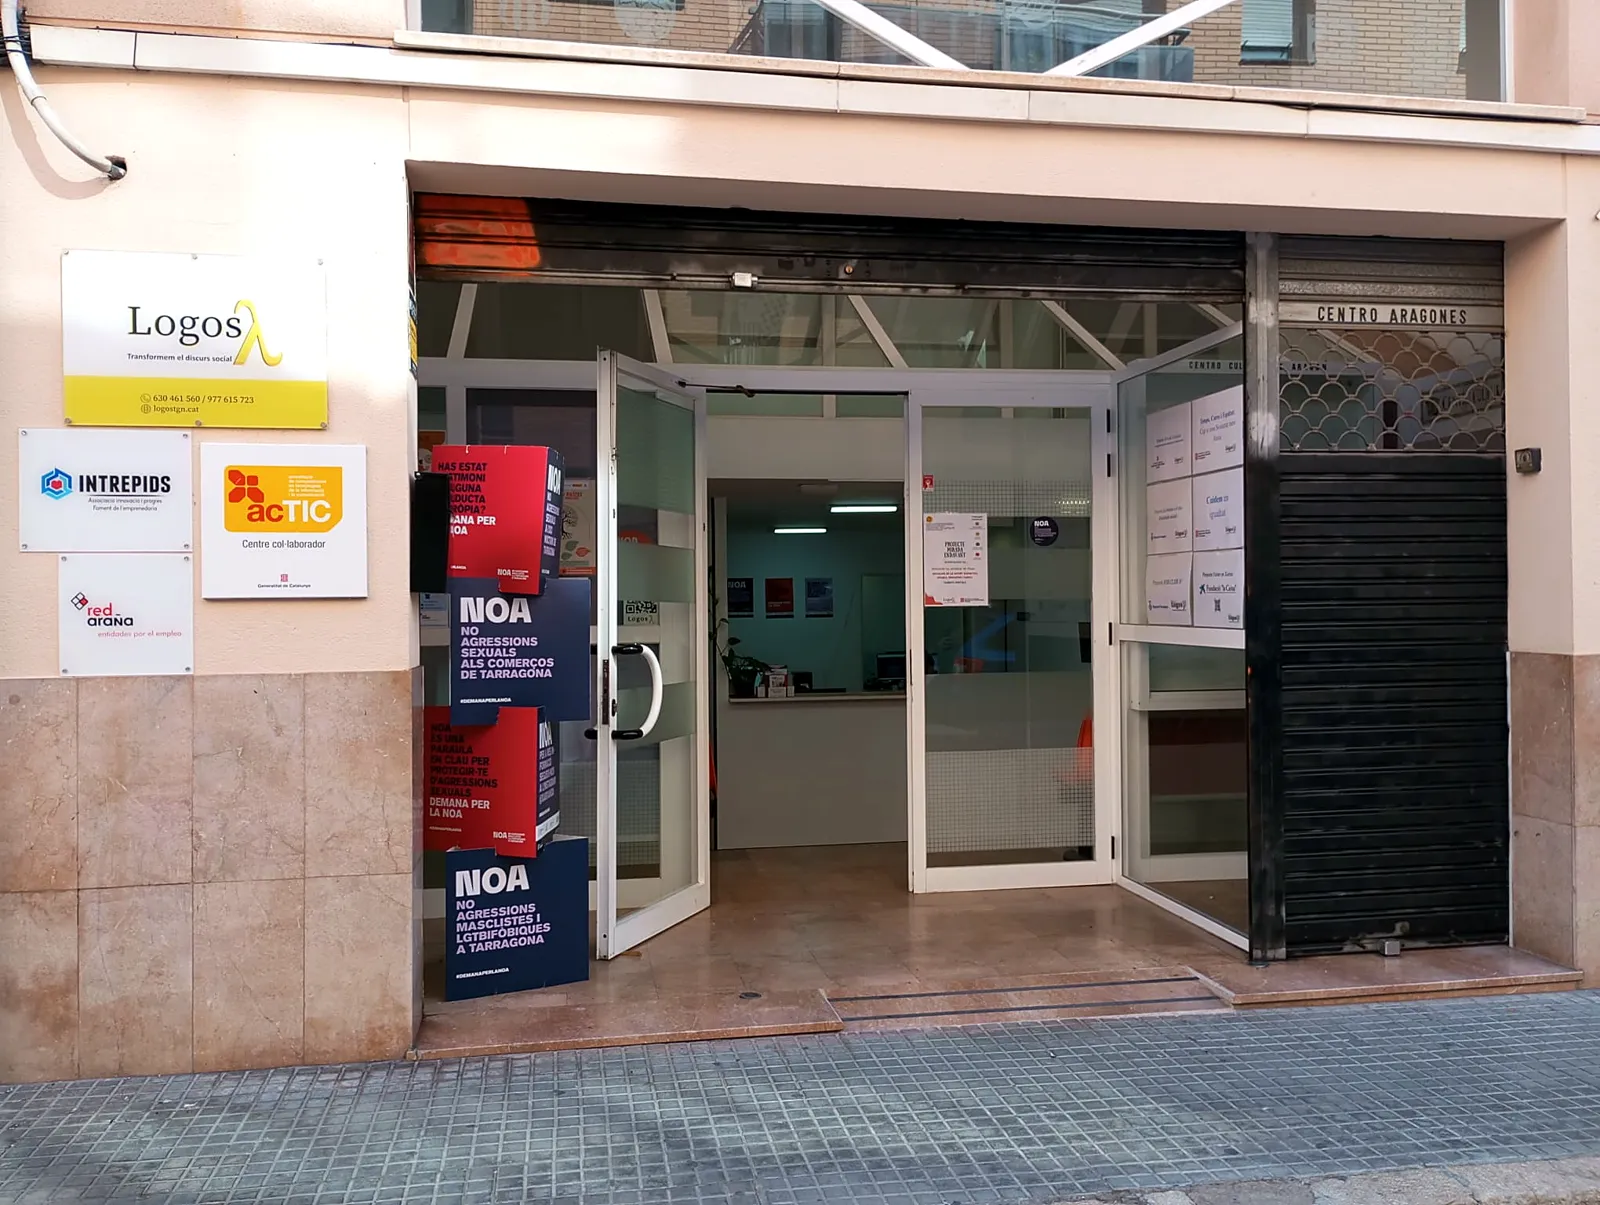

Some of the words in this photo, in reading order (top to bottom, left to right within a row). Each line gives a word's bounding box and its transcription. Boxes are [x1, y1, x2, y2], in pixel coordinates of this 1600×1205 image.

[1317, 305, 1379, 323] CENTRO
[1389, 306, 1468, 325] ARAGONES
[127, 306, 242, 347] Logos
[127, 353, 175, 361] Transformem
[177, 353, 184, 361] el
[185, 354, 210, 362] discurs
[212, 354, 233, 362] social
[1188, 361, 1222, 371] CENTRO
[1228, 361, 1243, 371] CUL
[153, 394, 168, 402] 630
[169, 394, 183, 403] 461
[186, 395, 201, 403] 560
[207, 395, 222, 404] 977
[223, 396, 238, 404] 615
[240, 396, 254, 404] 723
[153, 404, 199, 414] logostgn.cat
[438, 462, 456, 471] HAS
[458, 462, 487, 471] ESTAT
[79, 474, 171, 493] INTREPIDS
[450, 494, 486, 504] DUCTA
[247, 499, 332, 523] acTIC
[450, 515, 474, 525] ANA
[477, 515, 496, 525] PER
[450, 525, 468, 535] OA
[242, 539, 270, 549] Centre
[272, 539, 326, 549] col·laborador
[497, 568, 511, 576] NOA
[87, 602, 113, 616] red
[460, 596, 532, 623] NOA
[156, 630, 182, 638] empleo
[460, 626, 480, 636] NO
[460, 637, 538, 647] AGRESSIONS
[460, 647, 517, 658] SEXUALS
[460, 658, 485, 669] ALS
[487, 657, 555, 670] COMERÇOS
[460, 669, 478, 680] DE
[479, 668, 553, 679] TARRAGONA
[444, 733, 465, 743] UNA
[430, 744, 474, 754] PARAULA
[444, 755, 469, 765] CLAU
[471, 756, 490, 766] PER
[430, 765, 489, 776] PROTEGIR-TE
[429, 776, 498, 788] D'AGRESSIONS
[429, 796, 469, 808] DEMANA
[471, 799, 490, 809] PER
[429, 807, 441, 817] LA
[442, 808, 463, 819] NOA
[493, 831, 508, 839] NOA
[455, 864, 530, 898] NOA
[456, 899, 475, 911] NO
[456, 903, 536, 921] AGRESSIONS
[456, 913, 534, 932] MASCLISTES
[536, 913, 541, 923] I
[456, 923, 551, 943] LGTBIFÒBIQUES
[456, 944, 466, 954] A
[469, 934, 545, 953] TARRAGONA
[456, 967, 510, 979] #DEMANAPERLANOA
